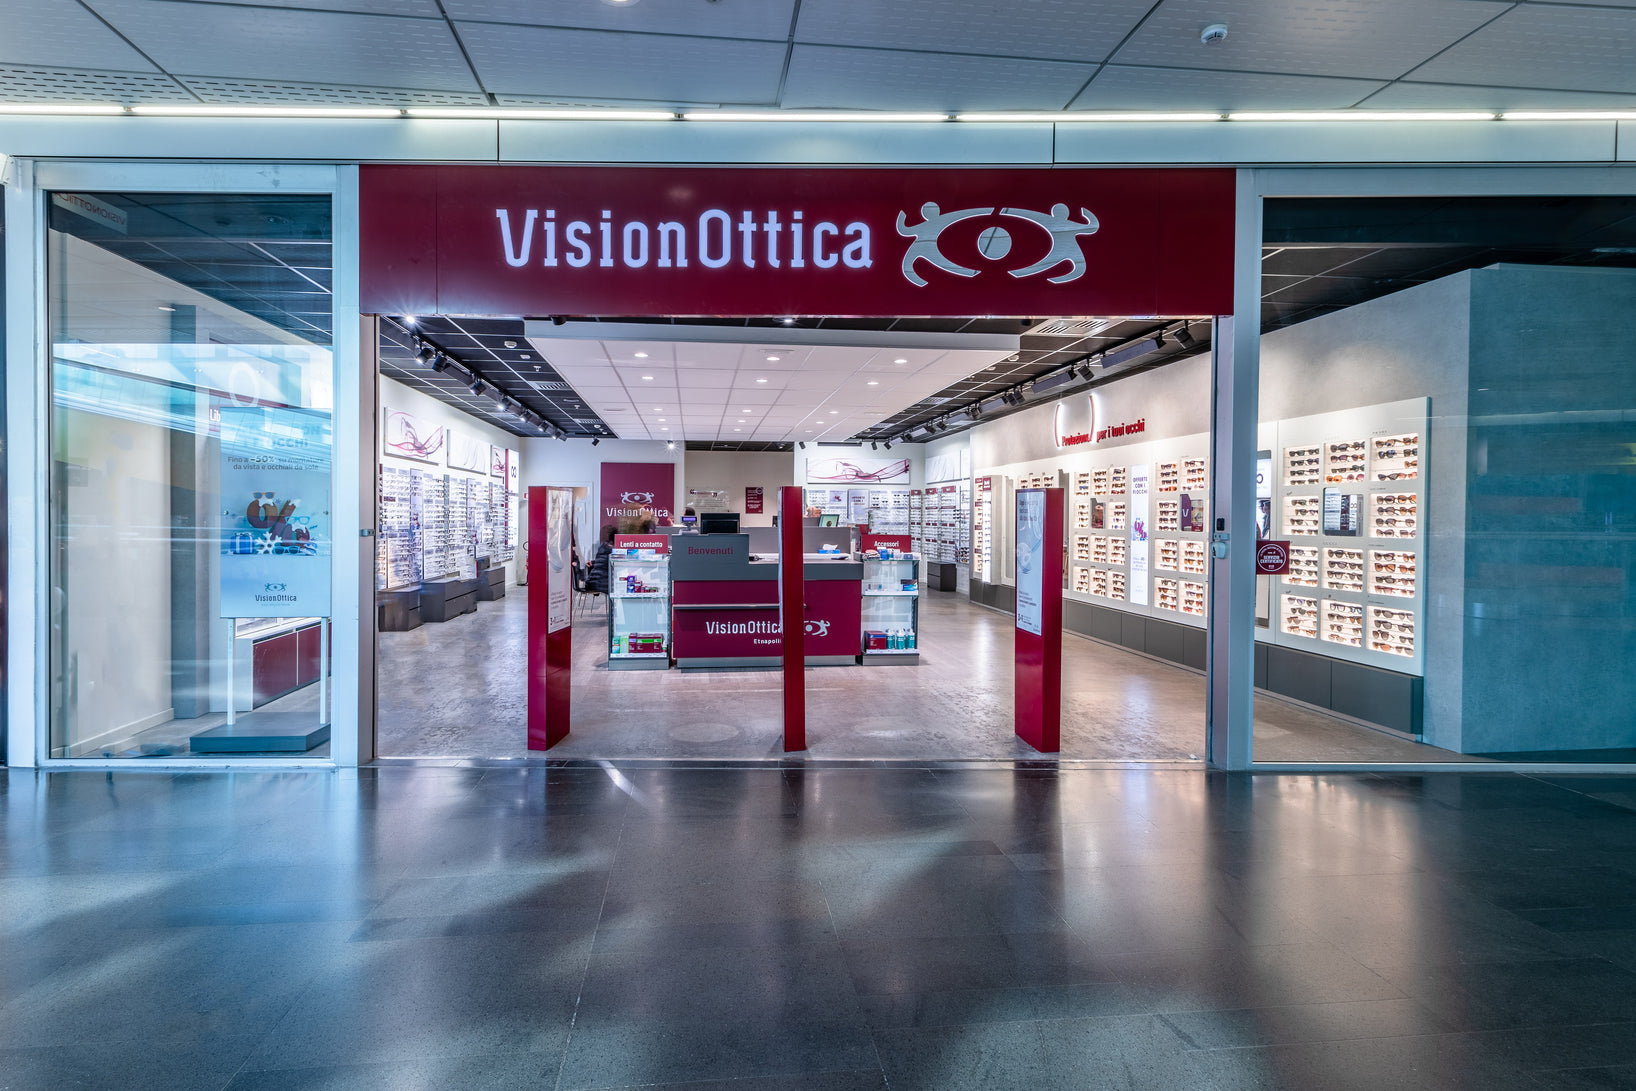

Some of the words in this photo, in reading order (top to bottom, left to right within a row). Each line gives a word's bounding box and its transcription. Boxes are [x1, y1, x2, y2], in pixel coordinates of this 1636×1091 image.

[495, 208, 874, 269] VisionOttica
[620, 540, 635, 548] Lenti
[874, 540, 900, 548] Accessori
[687, 545, 734, 555] Benvenuti
[255, 594, 297, 602] VisionOttica
